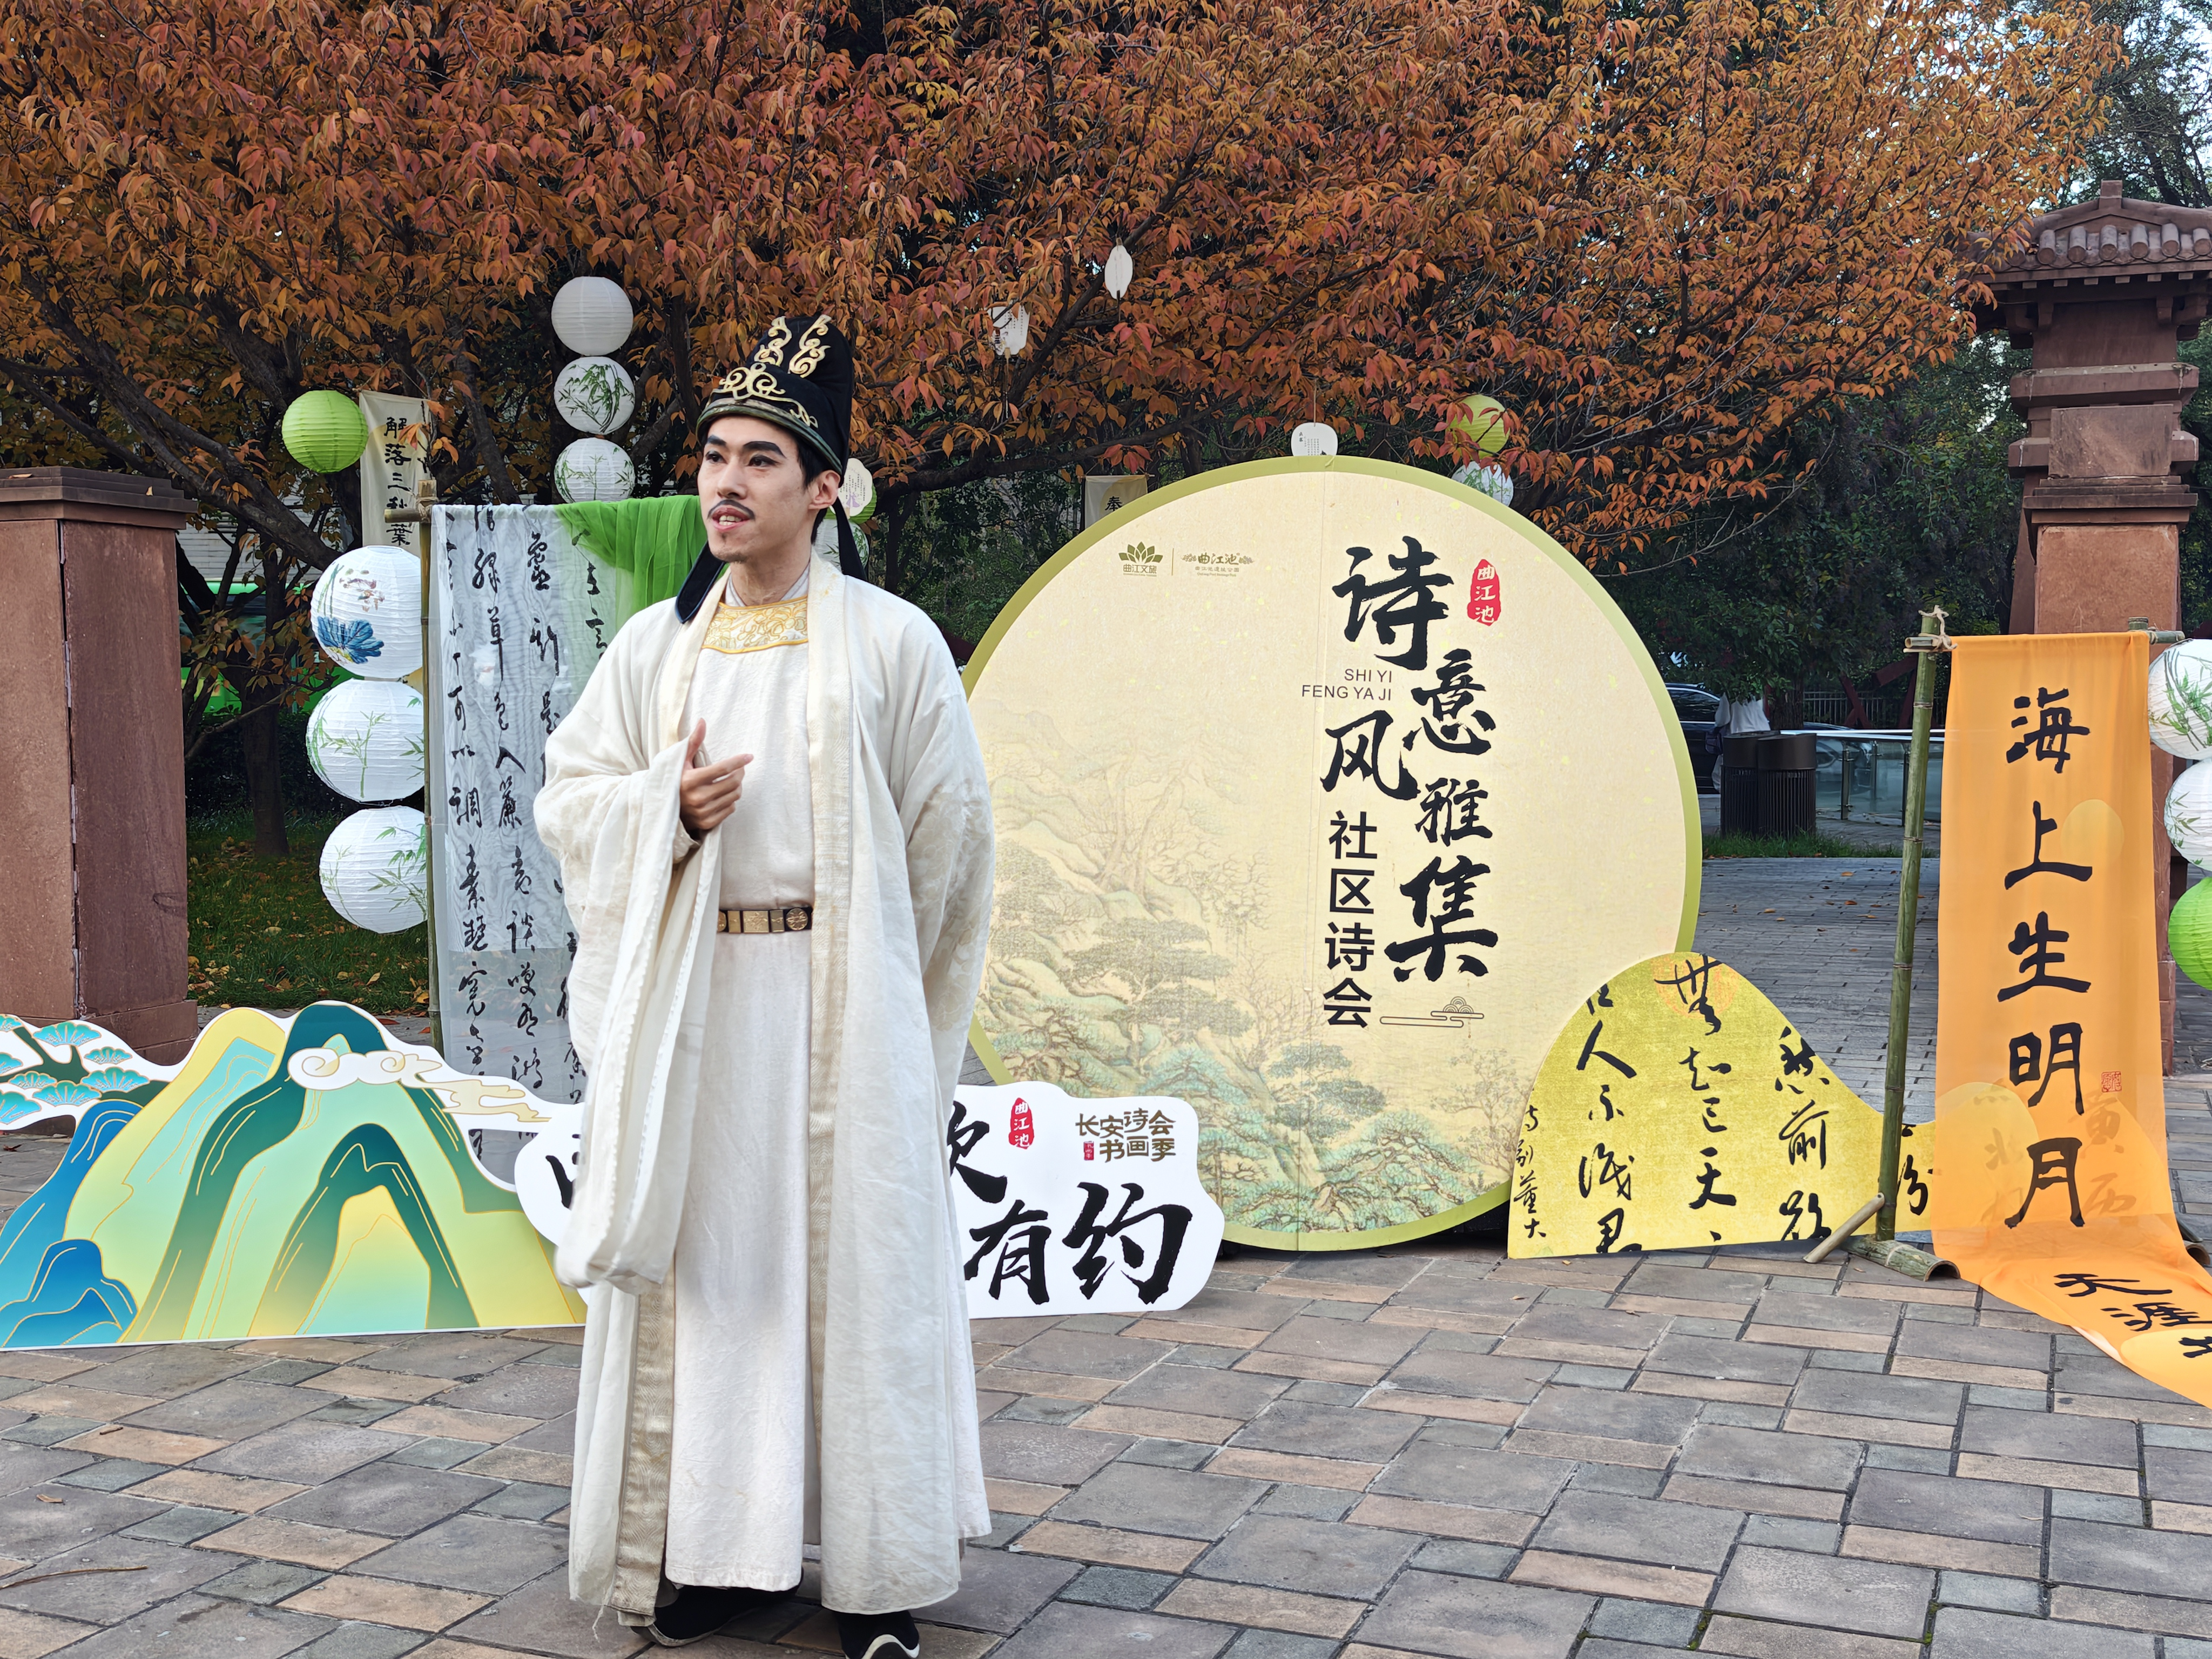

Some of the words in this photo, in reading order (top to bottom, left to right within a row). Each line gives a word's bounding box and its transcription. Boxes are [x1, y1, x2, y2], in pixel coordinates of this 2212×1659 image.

[1123, 564, 1157, 574] 曲江文旅
[1198, 552, 1239, 565] 曲江池
[1474, 564, 1496, 624] 曲江池
[1344, 669, 1372, 682] SHI
[1377, 670, 1392, 683] YI
[1301, 685, 1348, 699] FENG
[1354, 687, 1374, 700] YA
[1378, 689, 1392, 701] JI
[1323, 810, 1378, 1028] 社区诗会
[1997, 687, 2093, 1229] 海上生明月
[1014, 1102, 1030, 1147] 曲江池
[1075, 1108, 1176, 1138] 长安诗会
[1100, 1136, 1176, 1163] 书画季
